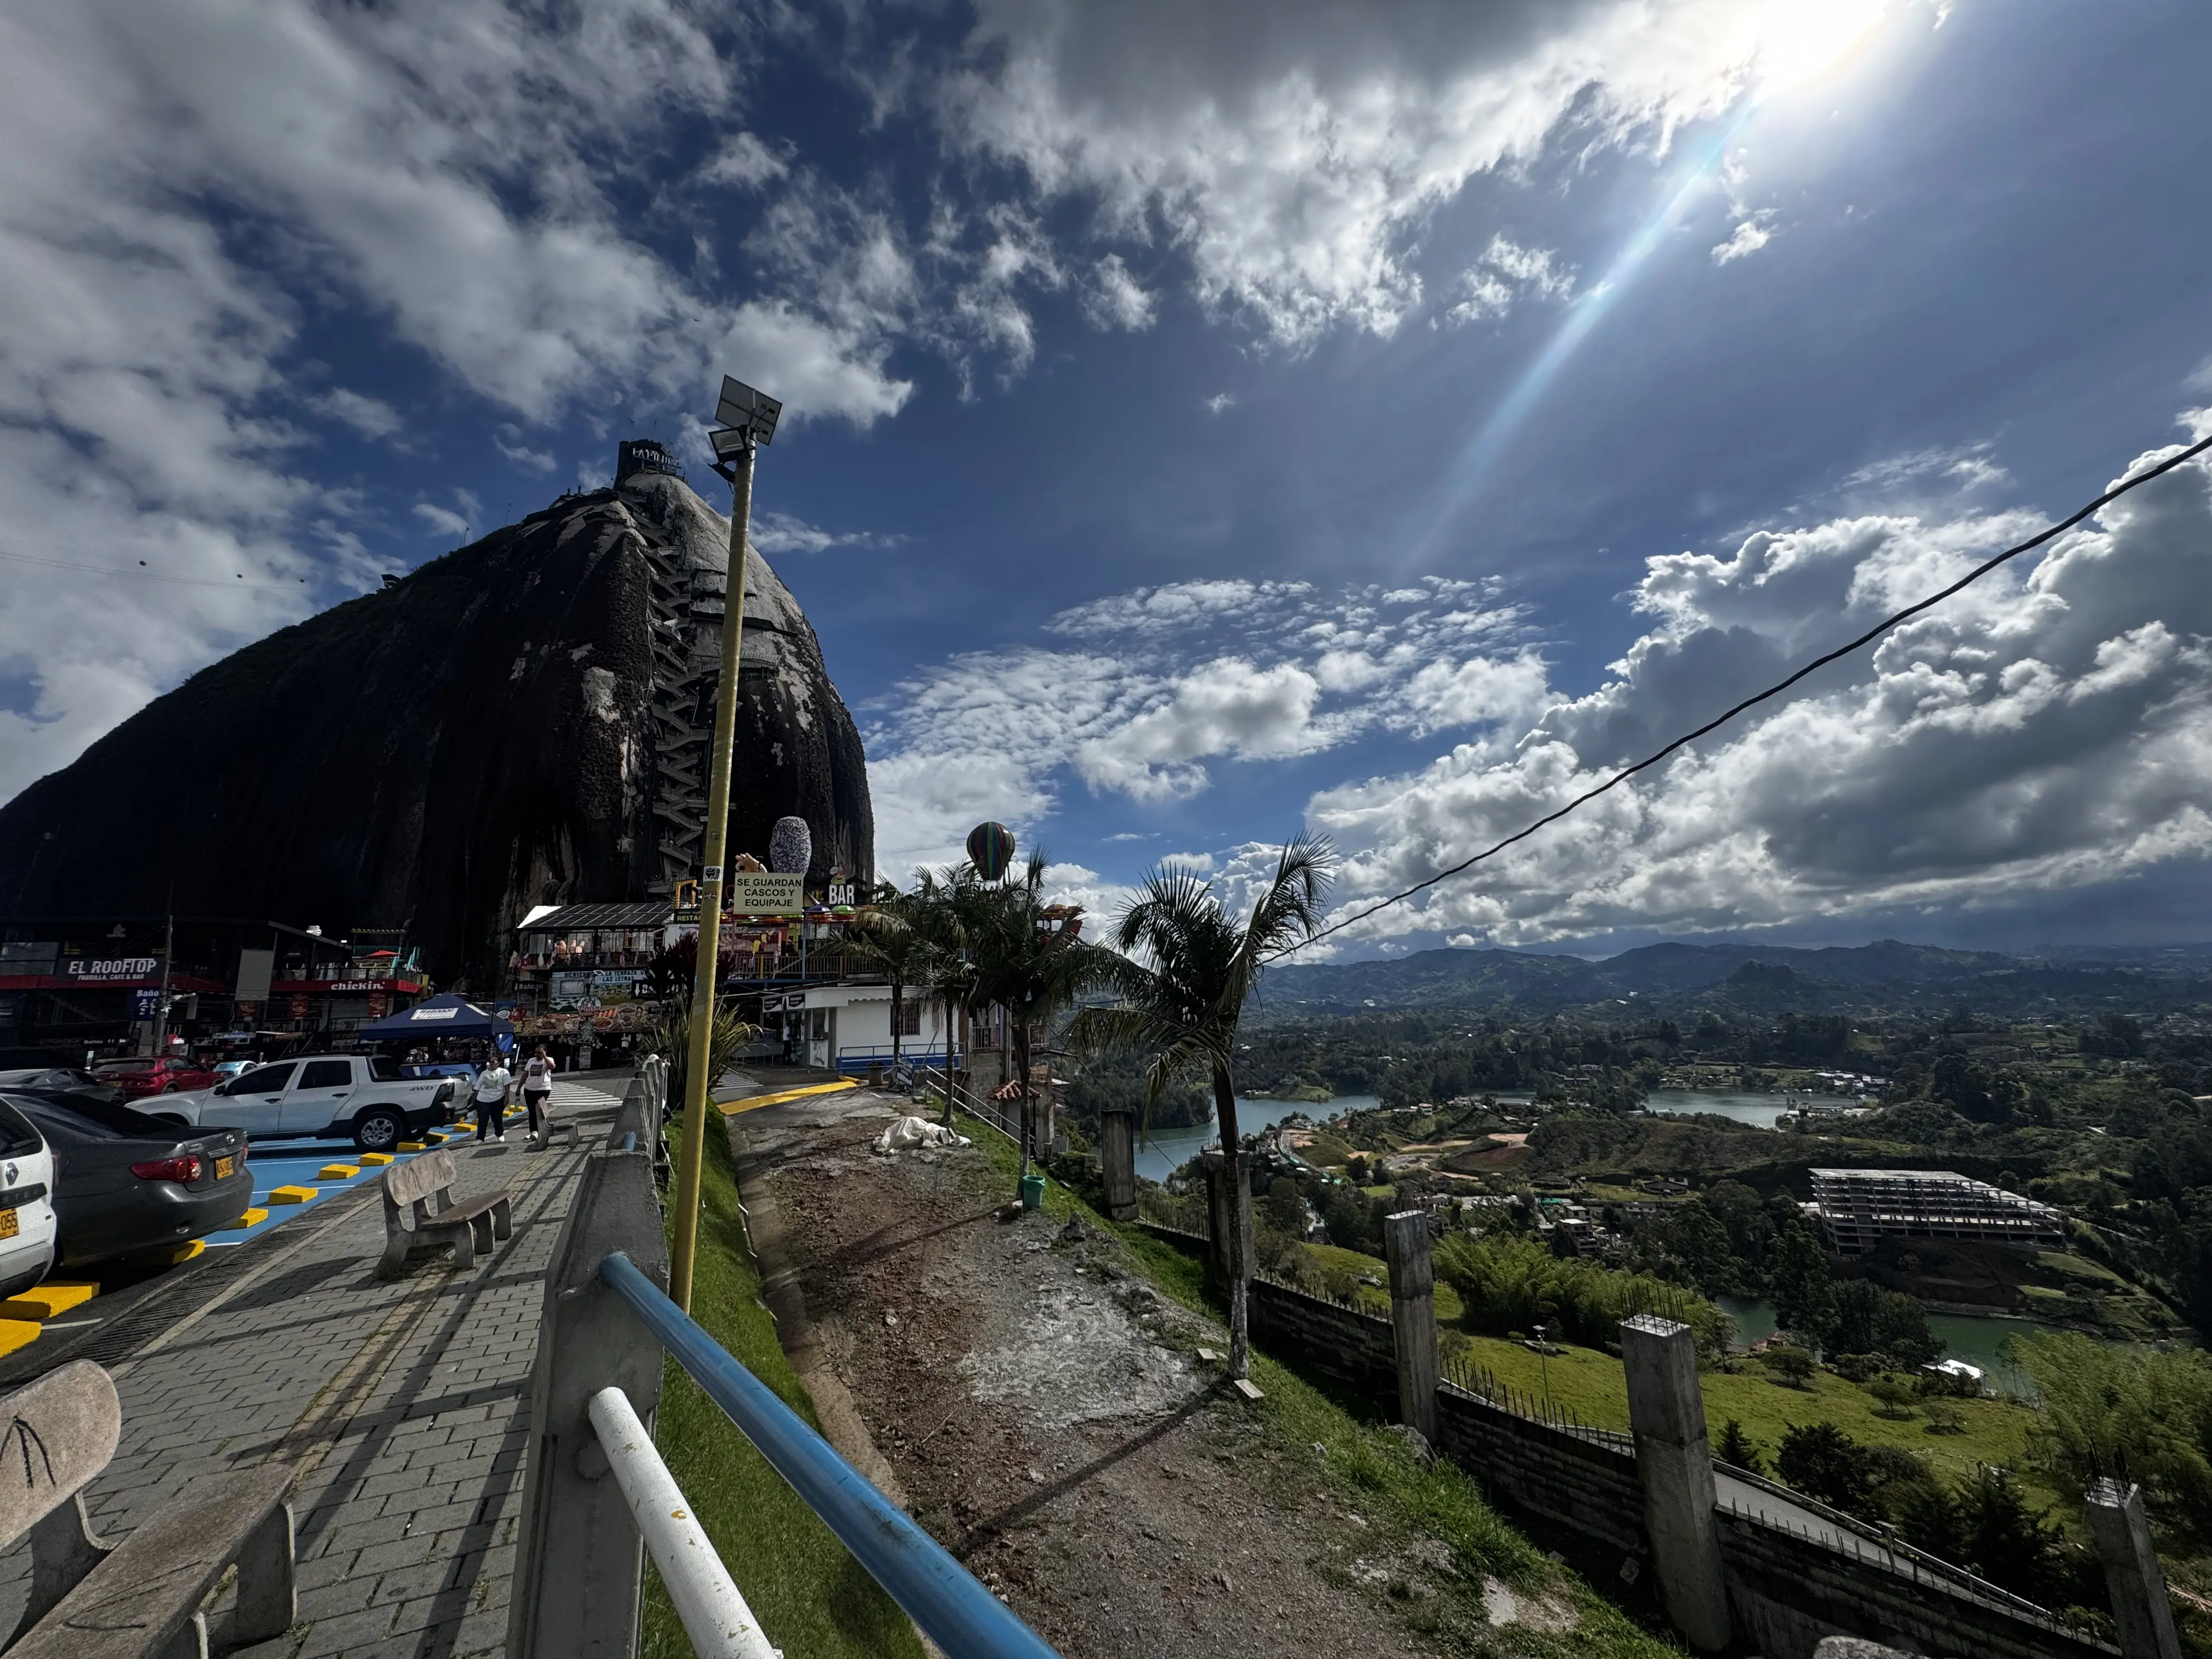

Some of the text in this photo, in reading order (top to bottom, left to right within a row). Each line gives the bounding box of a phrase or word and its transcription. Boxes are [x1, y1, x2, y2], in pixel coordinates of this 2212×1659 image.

[753, 878, 802, 887] GUARDAN
[829, 884, 855, 905] BAR
[67, 958, 157, 974] EL ROOFTOP
